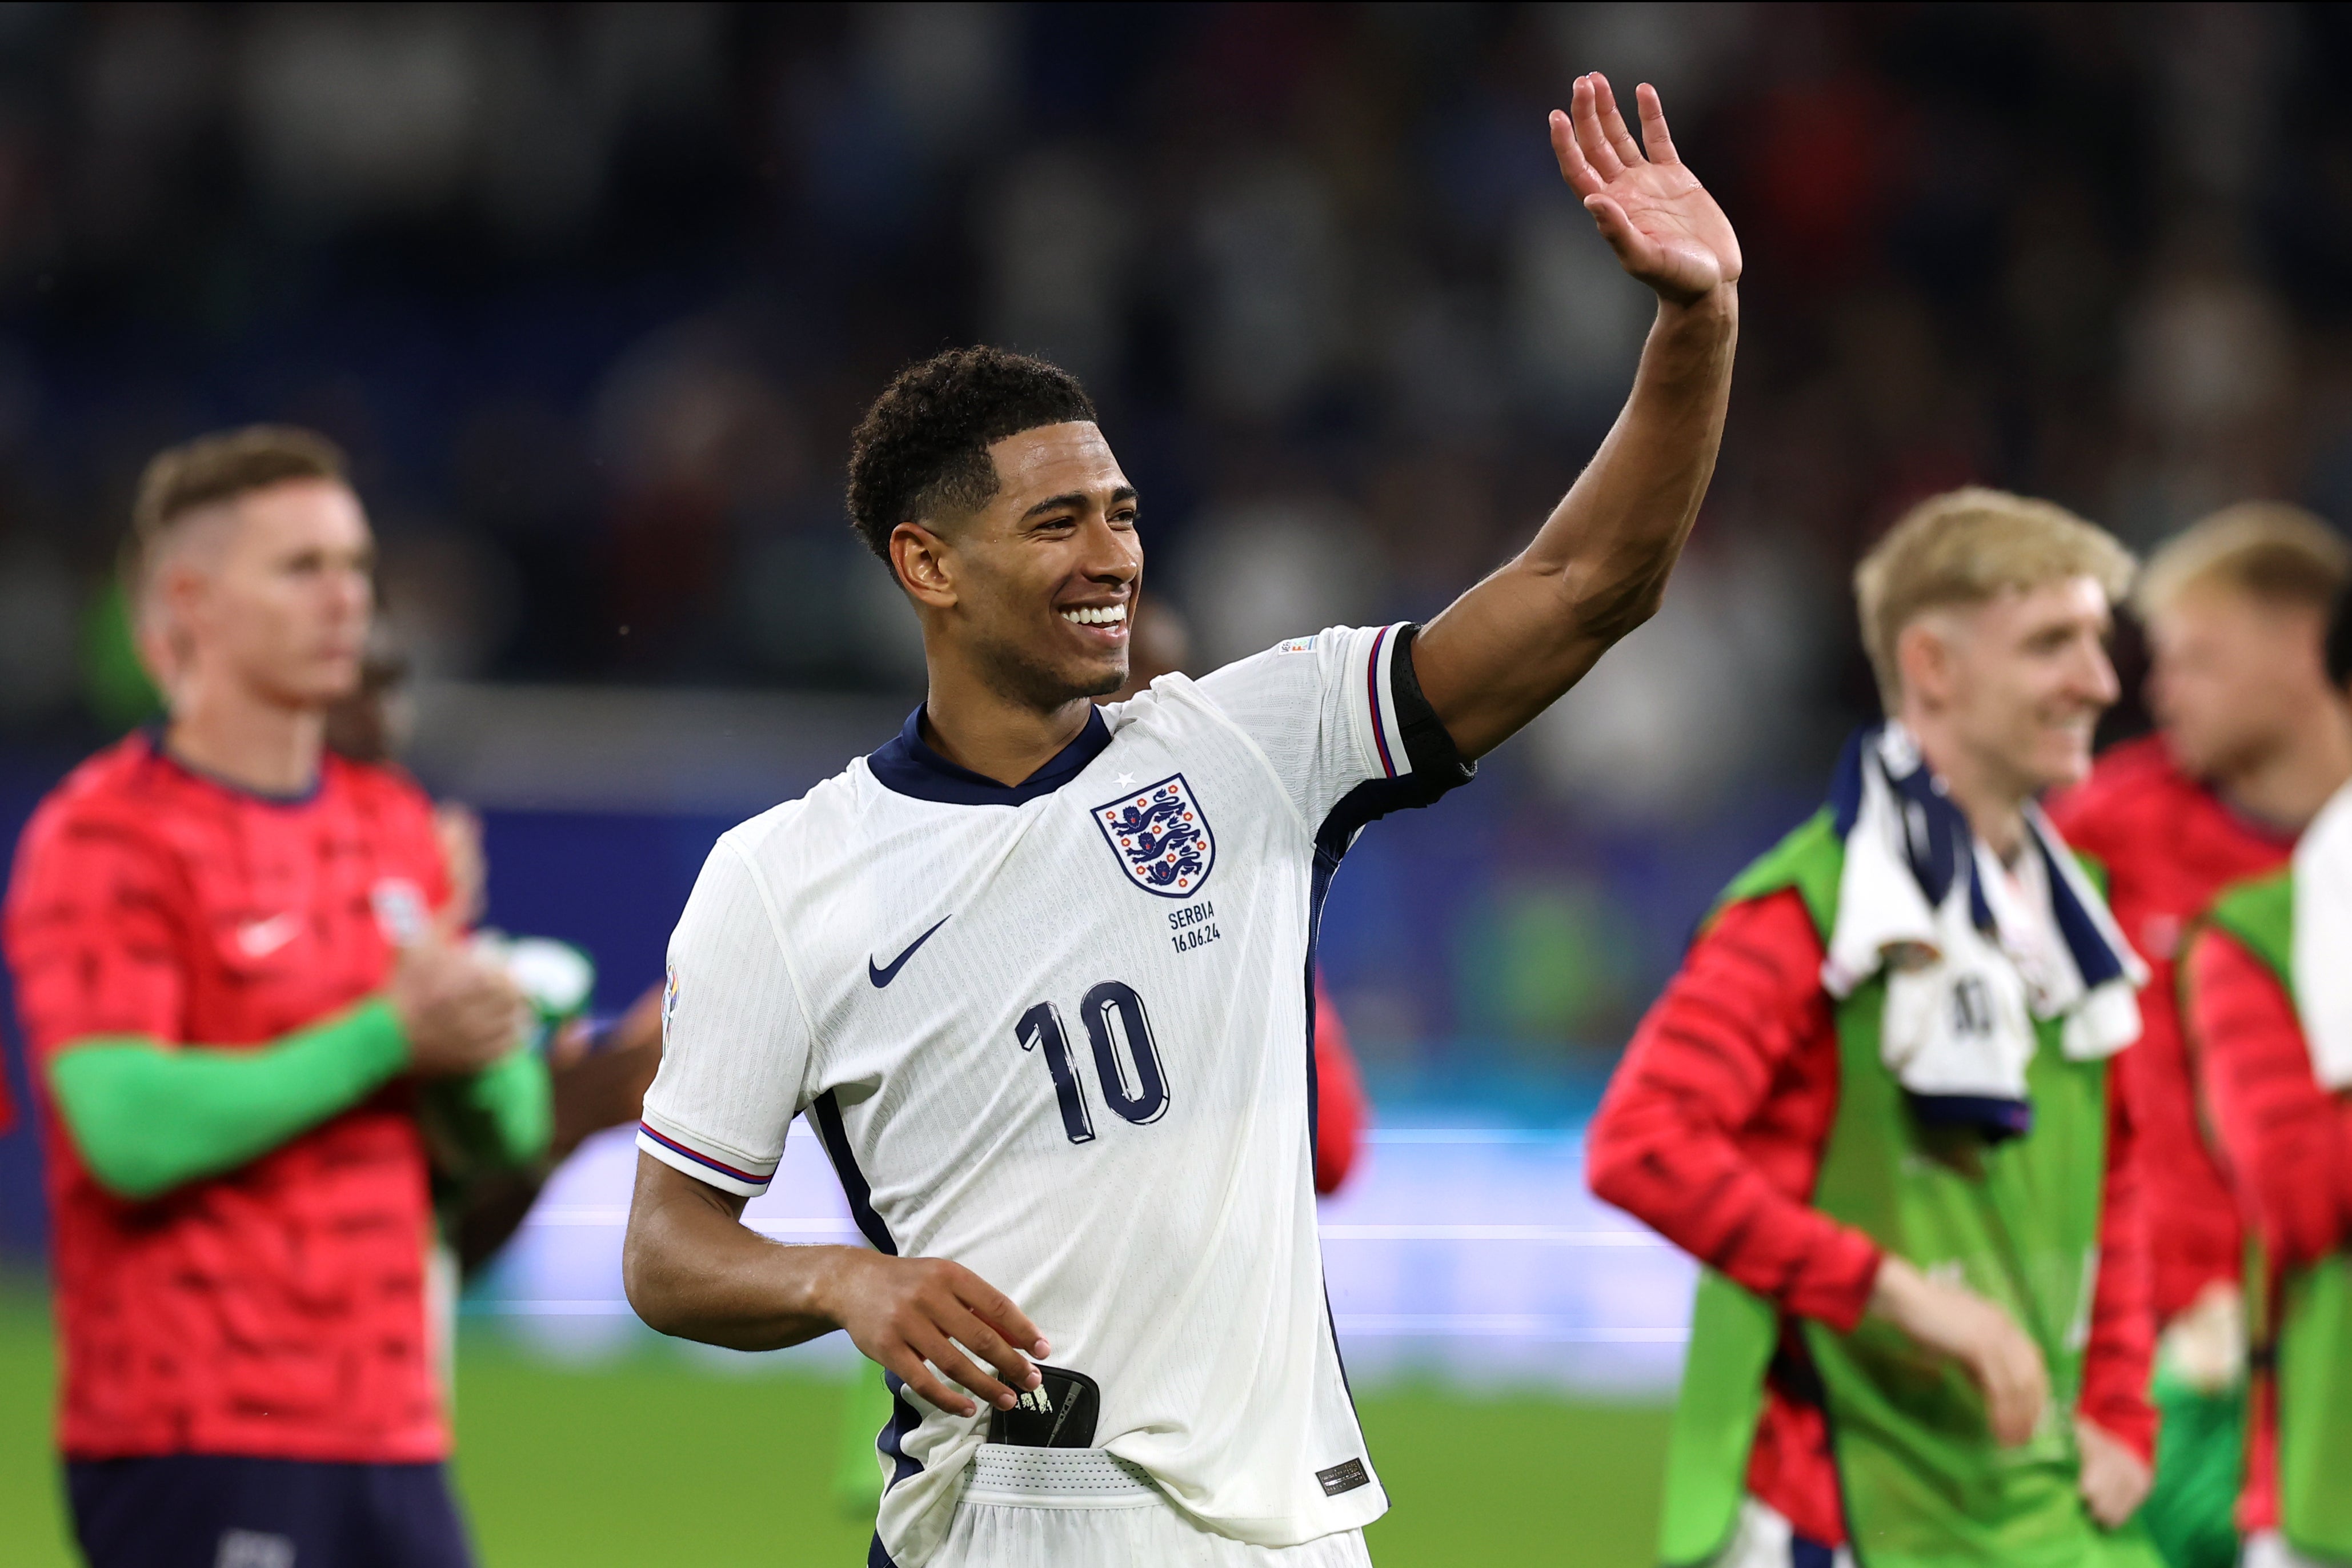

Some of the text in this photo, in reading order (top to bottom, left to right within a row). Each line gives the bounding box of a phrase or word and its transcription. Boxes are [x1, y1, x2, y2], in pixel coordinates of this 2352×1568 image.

[1168, 901, 1215, 930] SERBIA
[1172, 923, 1220, 953] 16.06.24
[1015, 980, 1171, 1144] 10
